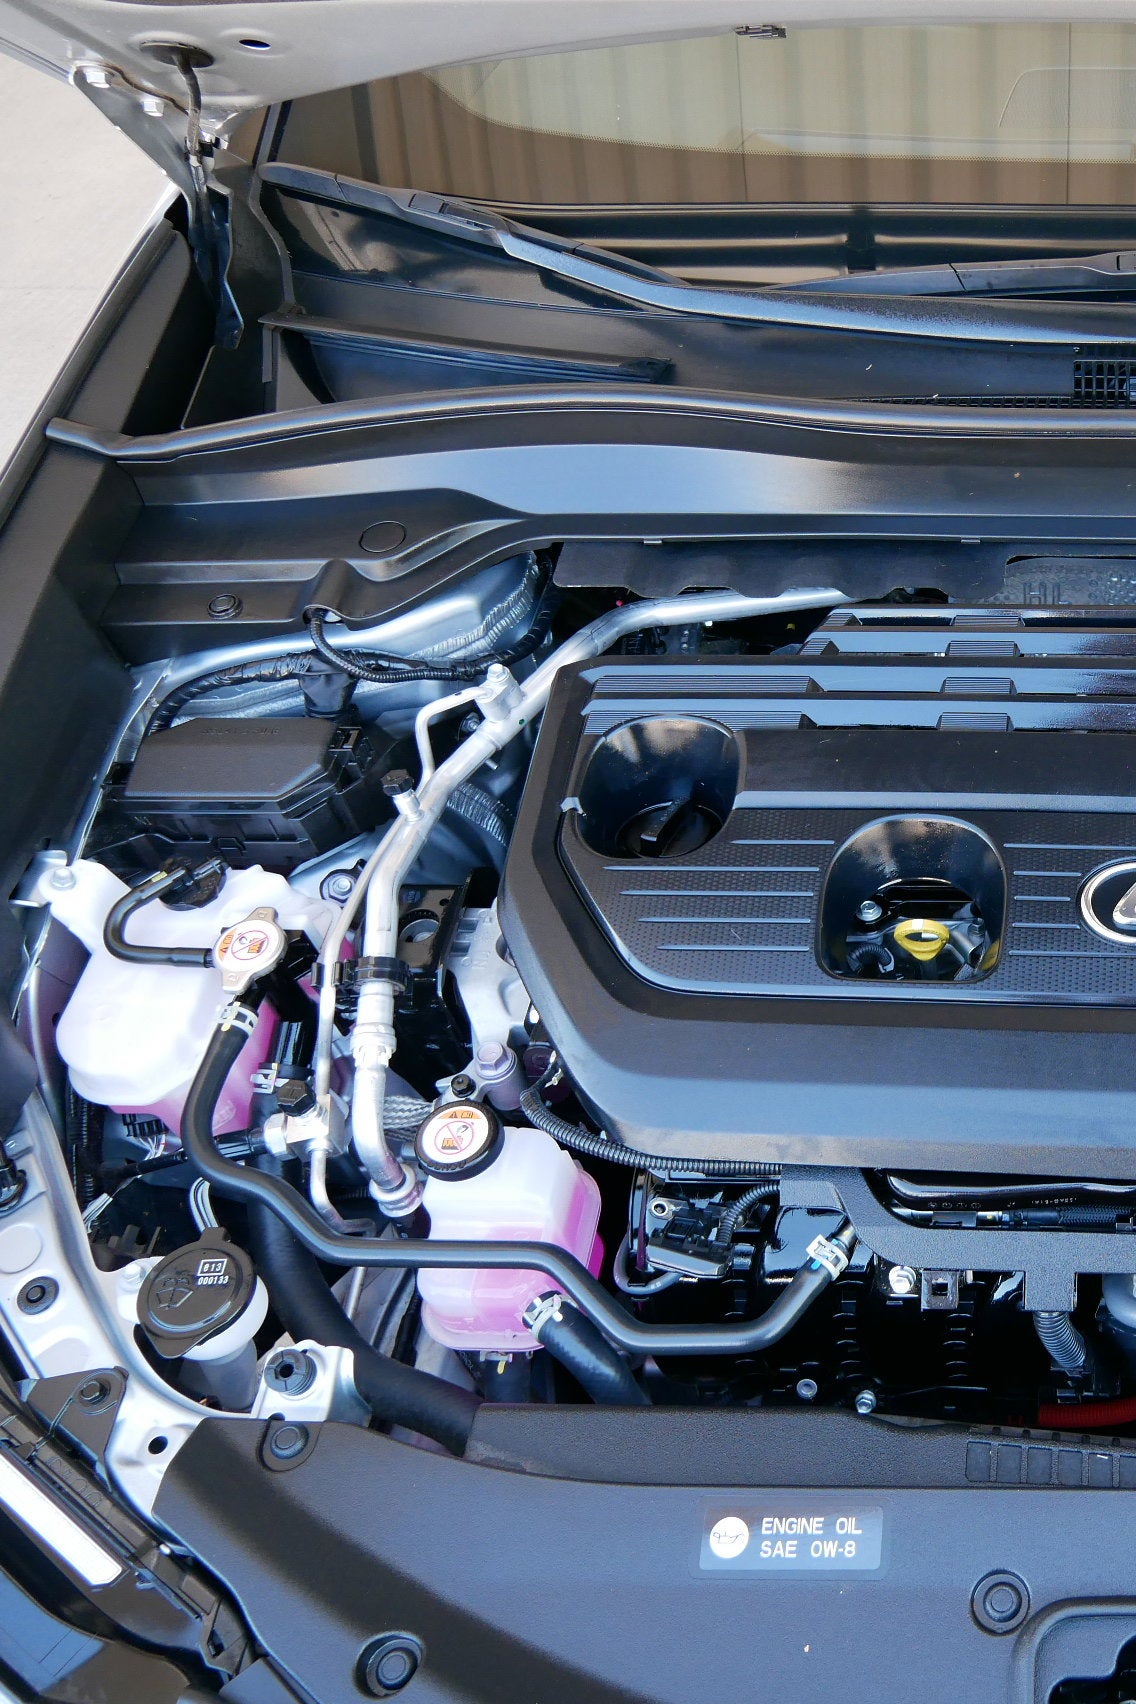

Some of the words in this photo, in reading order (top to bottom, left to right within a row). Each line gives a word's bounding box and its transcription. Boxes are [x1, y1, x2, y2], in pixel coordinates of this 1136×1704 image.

[197, 1275, 229, 1286] 000133
[761, 1517, 824, 1535] ENGINE
[835, 1517, 863, 1535] OIL
[759, 1540, 798, 1558] SAE
[810, 1540, 857, 1558] 0W-8
